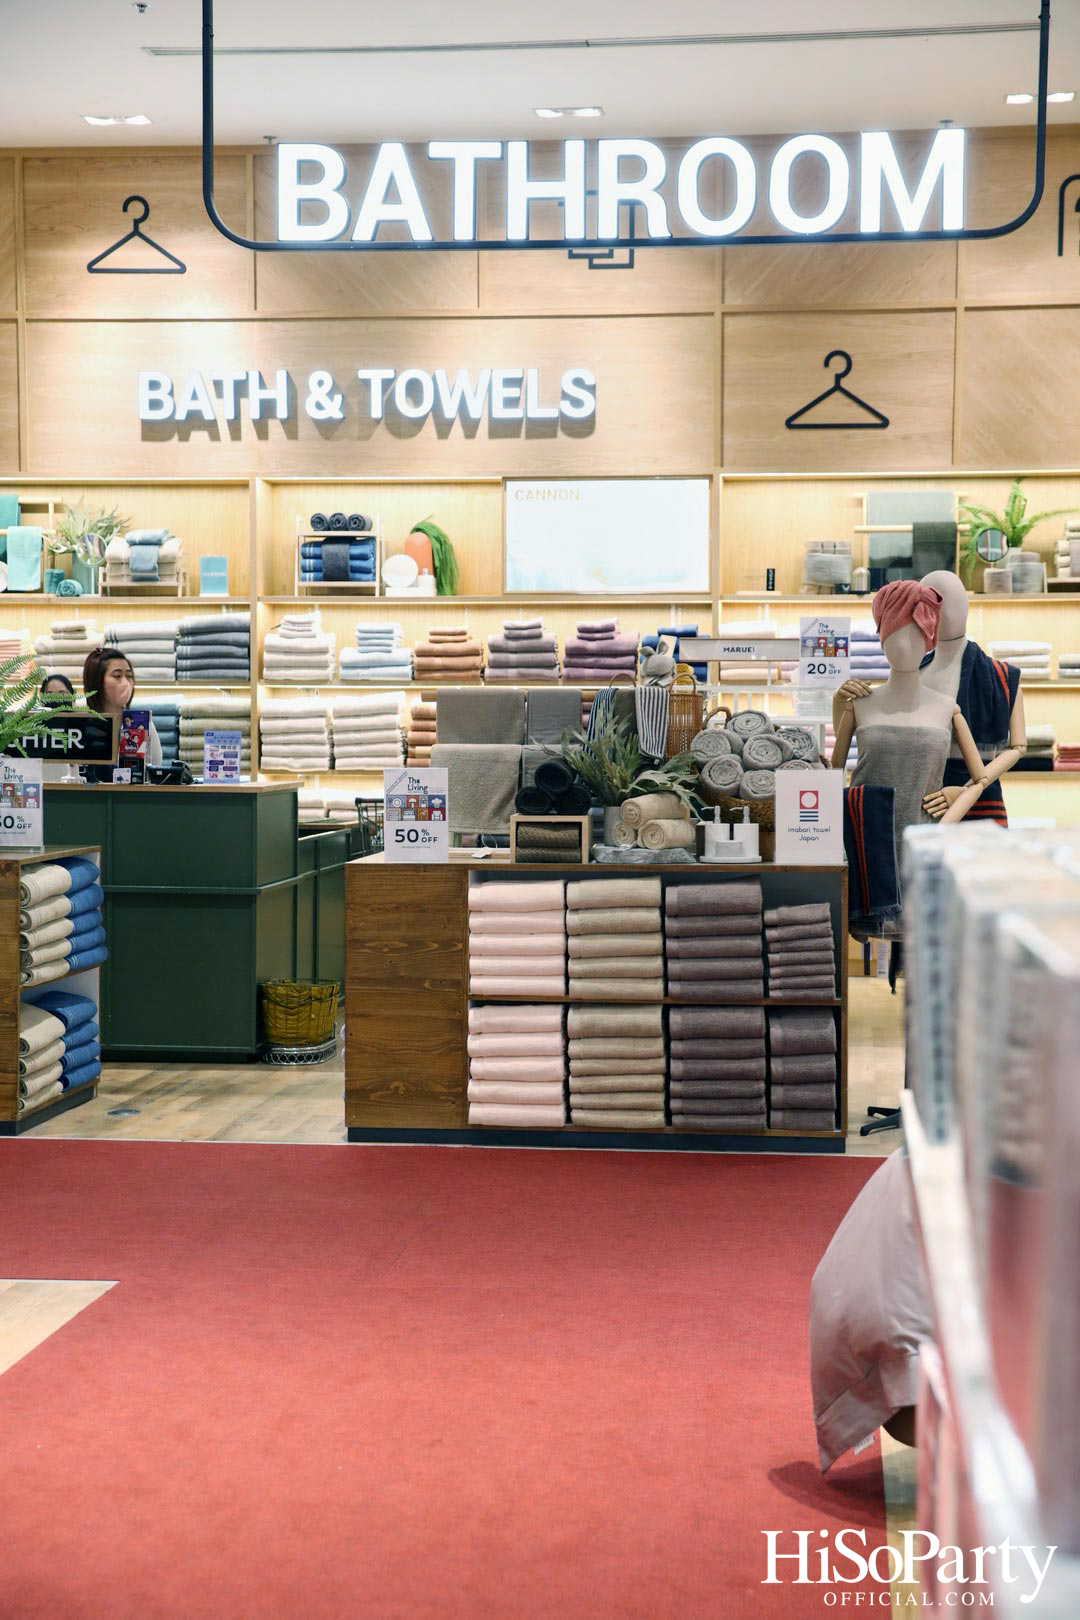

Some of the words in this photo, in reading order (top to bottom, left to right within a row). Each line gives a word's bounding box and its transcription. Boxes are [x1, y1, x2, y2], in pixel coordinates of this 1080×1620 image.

[276, 129, 966, 242] BATHROOM
[138, 370, 289, 420] BATH
[305, 370, 344, 419] &
[358, 368, 597, 418] TOWELS
[515, 488, 580, 502] CANNON
[818, 622, 829, 630] The
[807, 663, 827, 675] 20
[8, 728, 84, 749] HIER
[4, 773, 24, 783] Living
[407, 784, 428, 794] Living
[395, 829, 419, 843] 50
[421, 828, 430, 836] %
[799, 835, 819, 843] Japan
